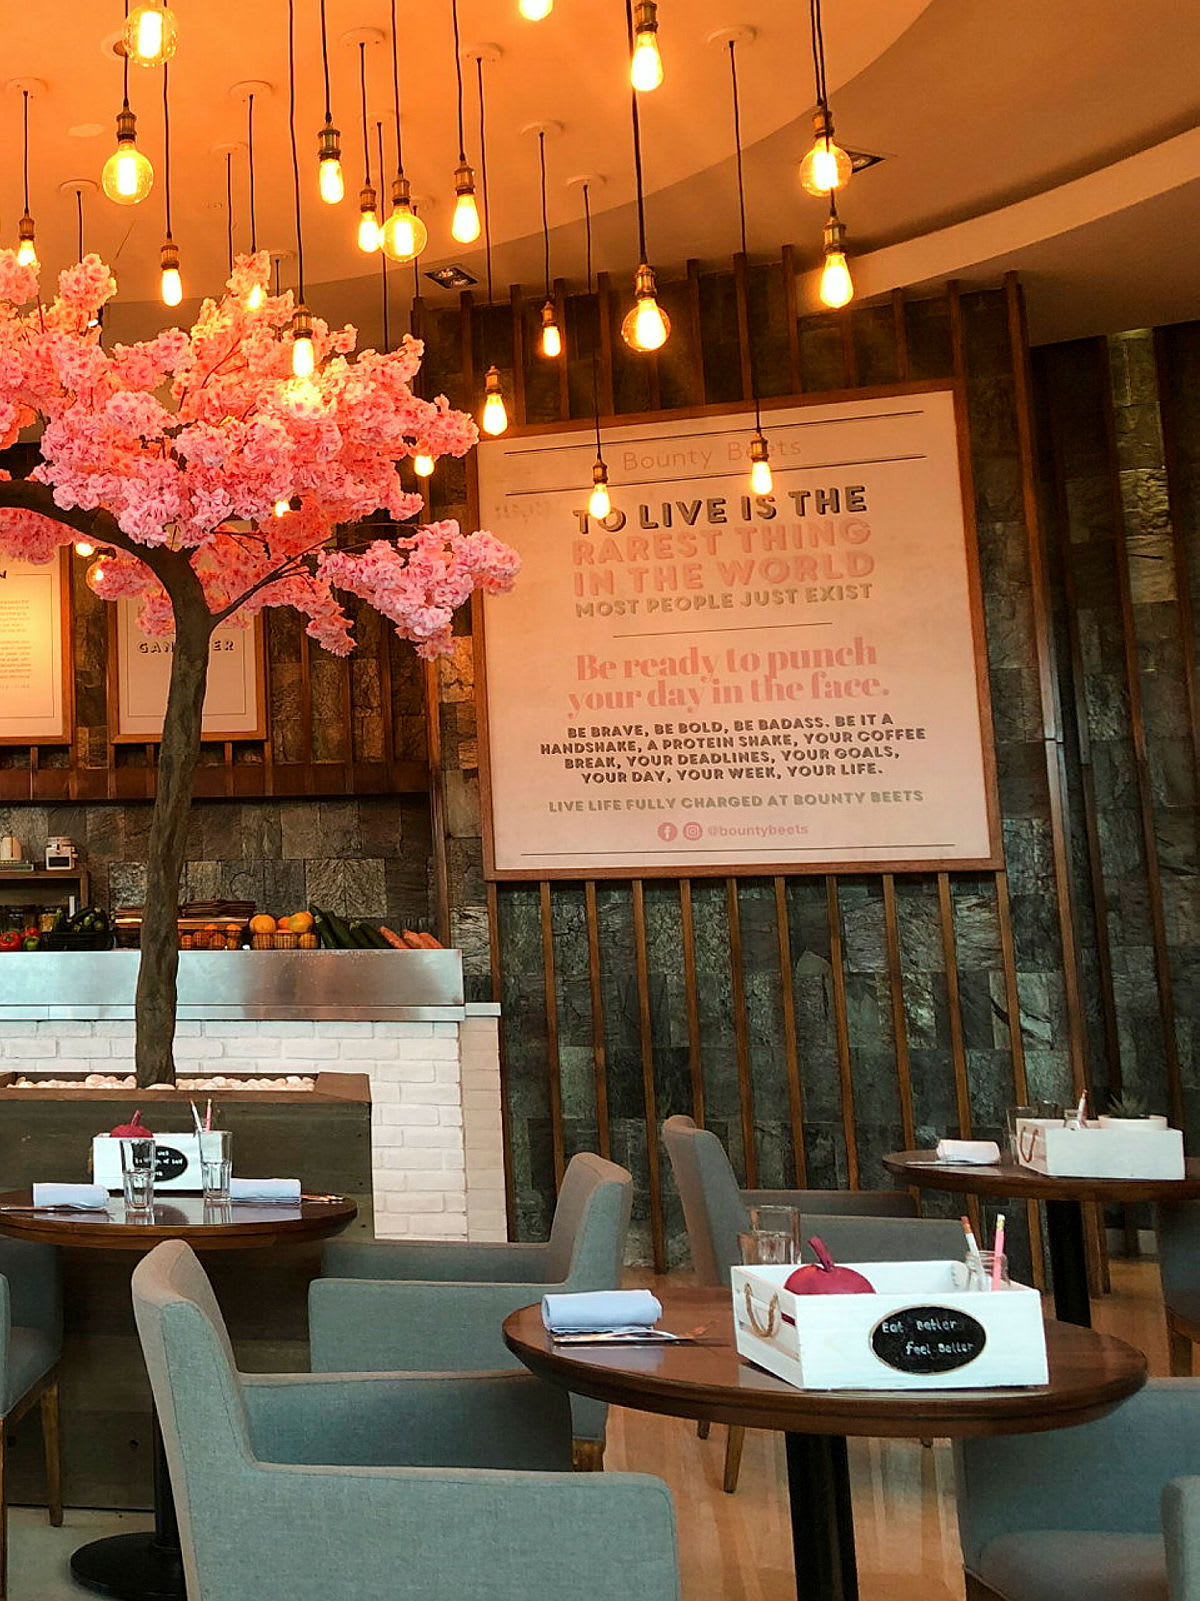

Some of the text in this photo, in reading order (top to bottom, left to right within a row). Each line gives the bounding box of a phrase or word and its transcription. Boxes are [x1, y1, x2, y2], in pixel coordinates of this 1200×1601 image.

[623, 450, 712, 470] Bounty
[572, 508, 626, 534] TO
[640, 498, 727, 529] LIVE
[741, 494, 777, 520] IS
[788, 486, 867, 517] THE
[572, 518, 871, 565] RAREST THING
[574, 550, 875, 597] IN THE WORLD
[575, 583, 873, 618] MOST PEOPLE JUST EXIST
[576, 636, 877, 682] Be ready to punch
[568, 670, 890, 719] your day in the face.
[567, 713, 893, 739] BE BRAVE, BE BOLD, BE BADASS. BE IT A
[540, 728, 926, 755] HANDSHAKE, A PROTEIN SHAKE, YOUR COFFEE
[564, 746, 900, 769] BREAK, YOUR DEADLINES, YOUR GOALS,
[581, 762, 883, 784] YOUR DAY, YOUR WEEK, YOUR LIFE.
[549, 790, 924, 813] LIVE LIFE FULLY CHARGED AT BOUNTY BEETS
[708, 824, 809, 838] @bountybeets
[882, 1318, 958, 1333] Eat Better
[937, 1342, 975, 1354] Better
